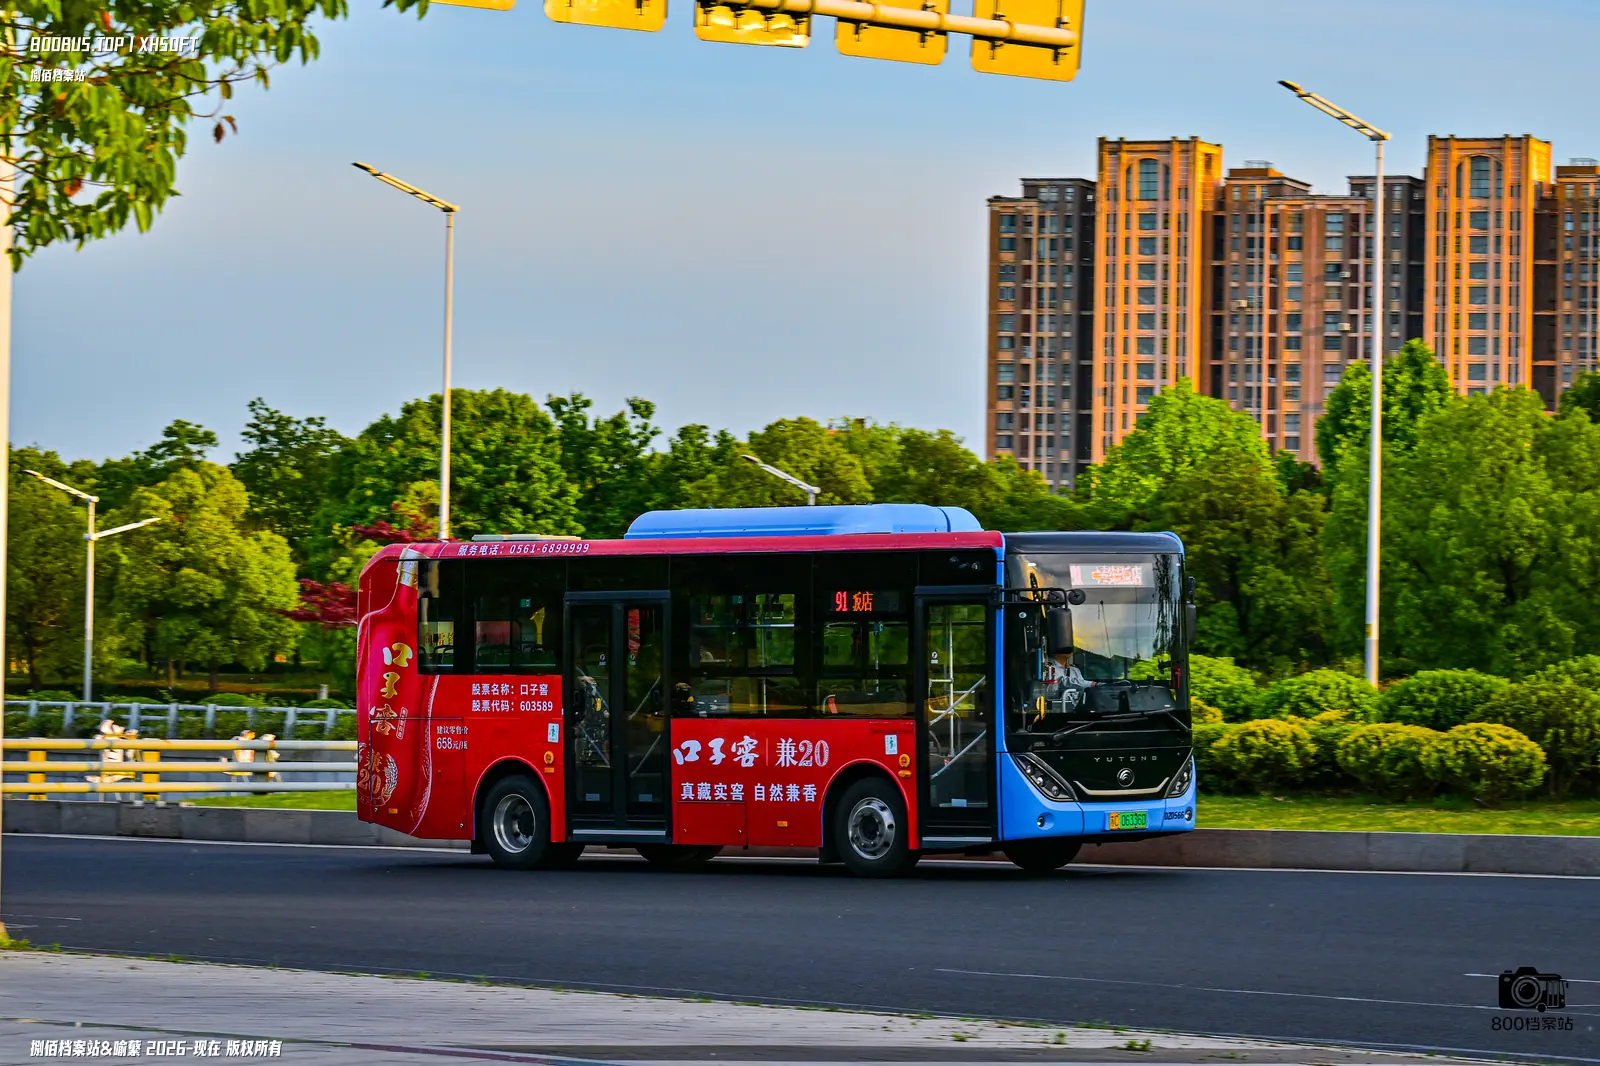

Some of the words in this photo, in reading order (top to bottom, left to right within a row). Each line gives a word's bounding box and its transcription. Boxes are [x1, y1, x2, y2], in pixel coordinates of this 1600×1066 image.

[835, 591, 849, 612] 91
[673, 735, 760, 768] 口子窖
[775, 737, 830, 768] 兼20
[1094, 755, 1158, 763] YUTONG
[680, 782, 745, 802] 真藏实窖
[754, 783, 818, 802] 自然兼香
